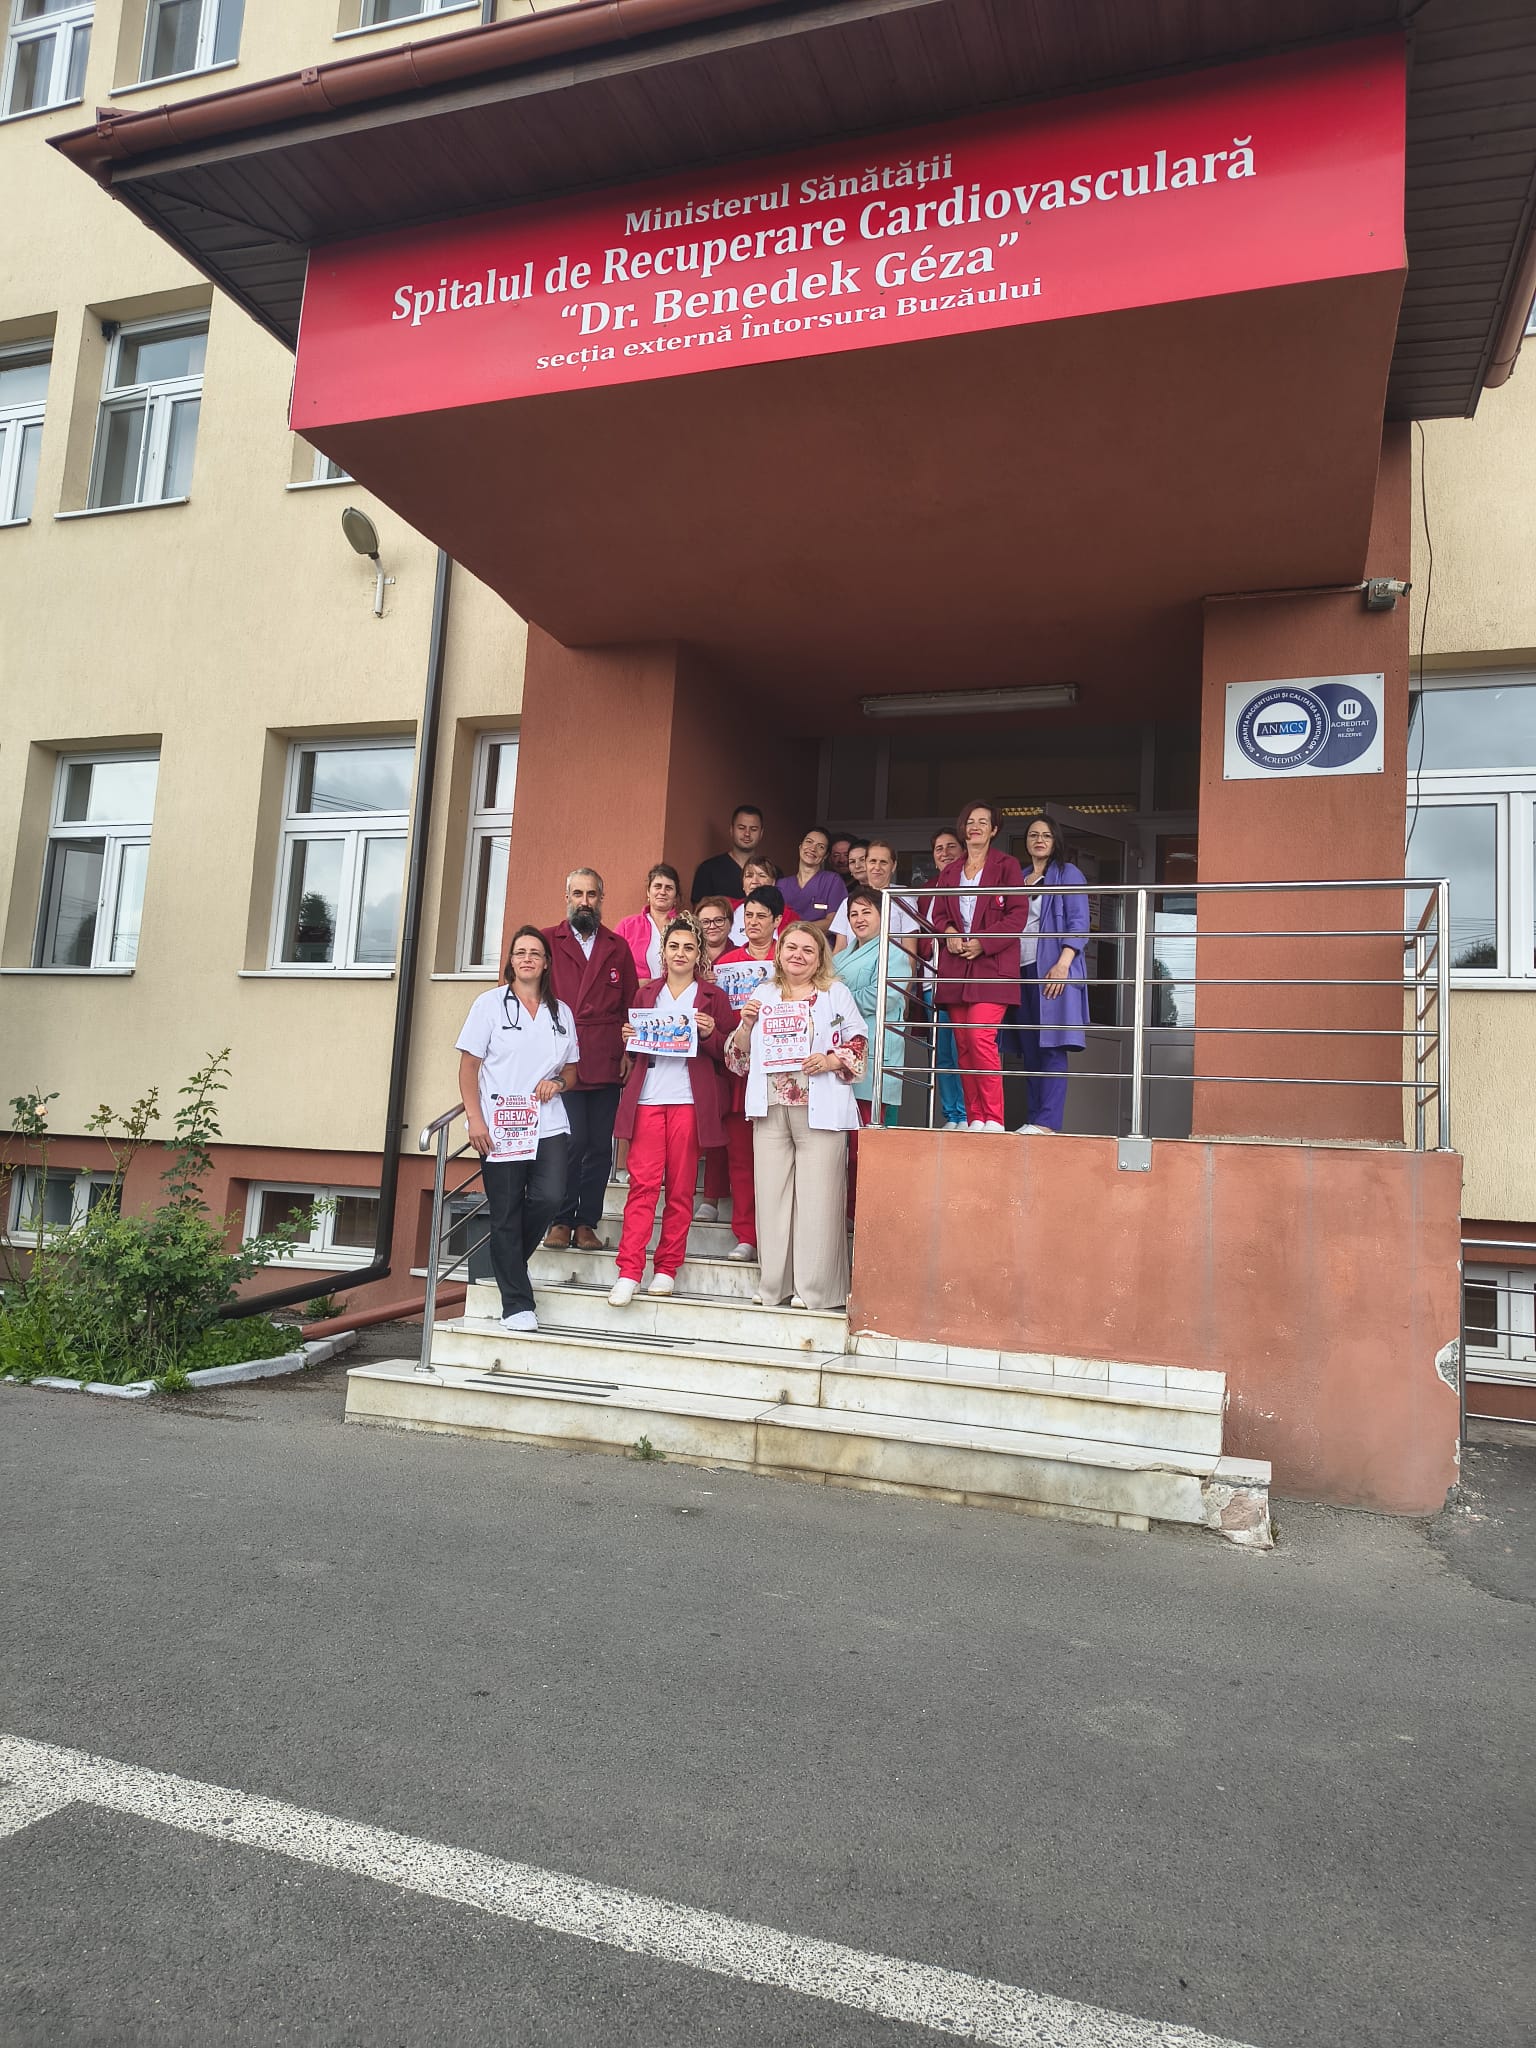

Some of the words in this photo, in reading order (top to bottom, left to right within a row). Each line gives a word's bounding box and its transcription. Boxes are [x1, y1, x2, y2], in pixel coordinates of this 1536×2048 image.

[624, 182, 790, 237] Ministerul
[799, 153, 953, 204] Sănătății
[392, 262, 535, 327] Spitalul
[544, 255, 592, 295] de
[601, 216, 846, 285] Recuperare
[859, 135, 1257, 240] Cardiovasculară
[536, 344, 616, 372] secția
[623, 324, 734, 358] externă
[741, 304, 887, 340] Întorsura
[896, 277, 1043, 317] Buzăului
[652, 260, 862, 326] Benedek
[1261, 722, 1304, 735] ANMCS
[1330, 719, 1370, 728] ACREDITAT
[1262, 753, 1302, 764] ACREDITAT
